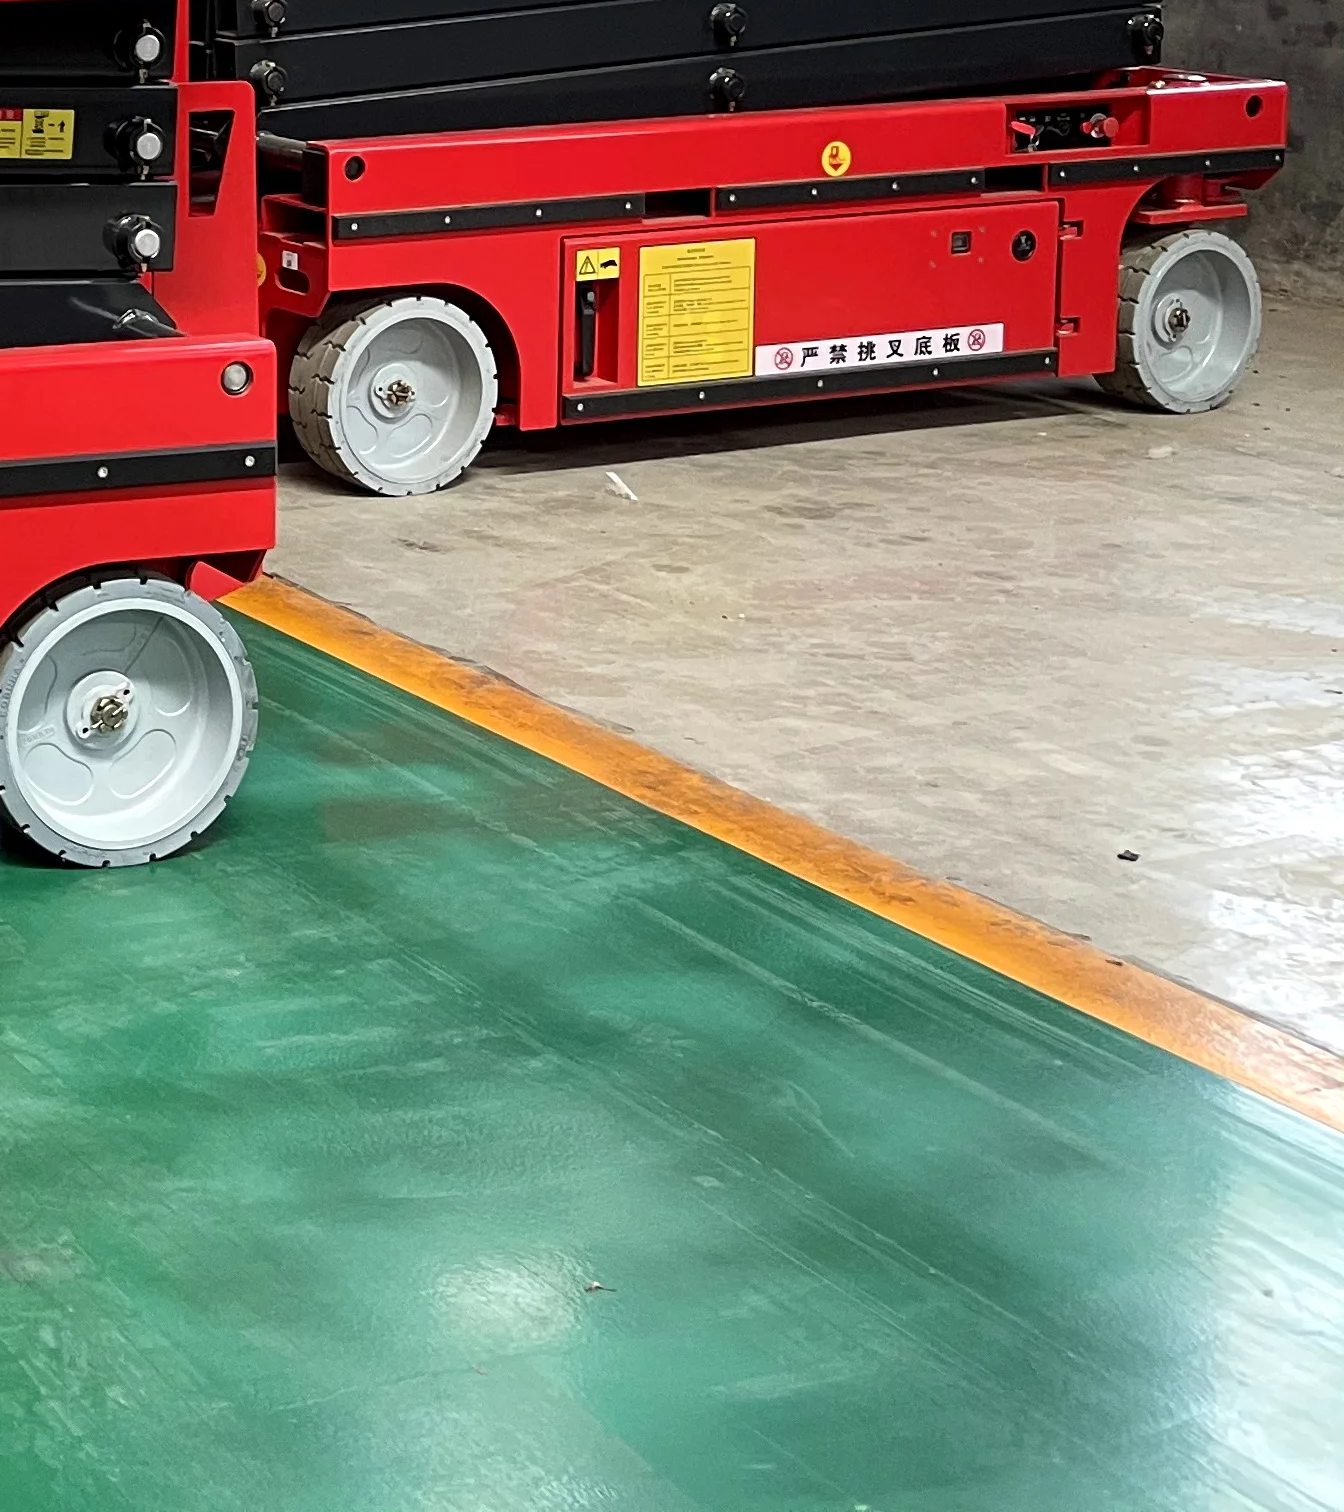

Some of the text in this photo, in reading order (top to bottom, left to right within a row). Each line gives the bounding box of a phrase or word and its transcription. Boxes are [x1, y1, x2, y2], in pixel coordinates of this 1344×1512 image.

[800, 332, 961, 368] 严禁挑叉底板
